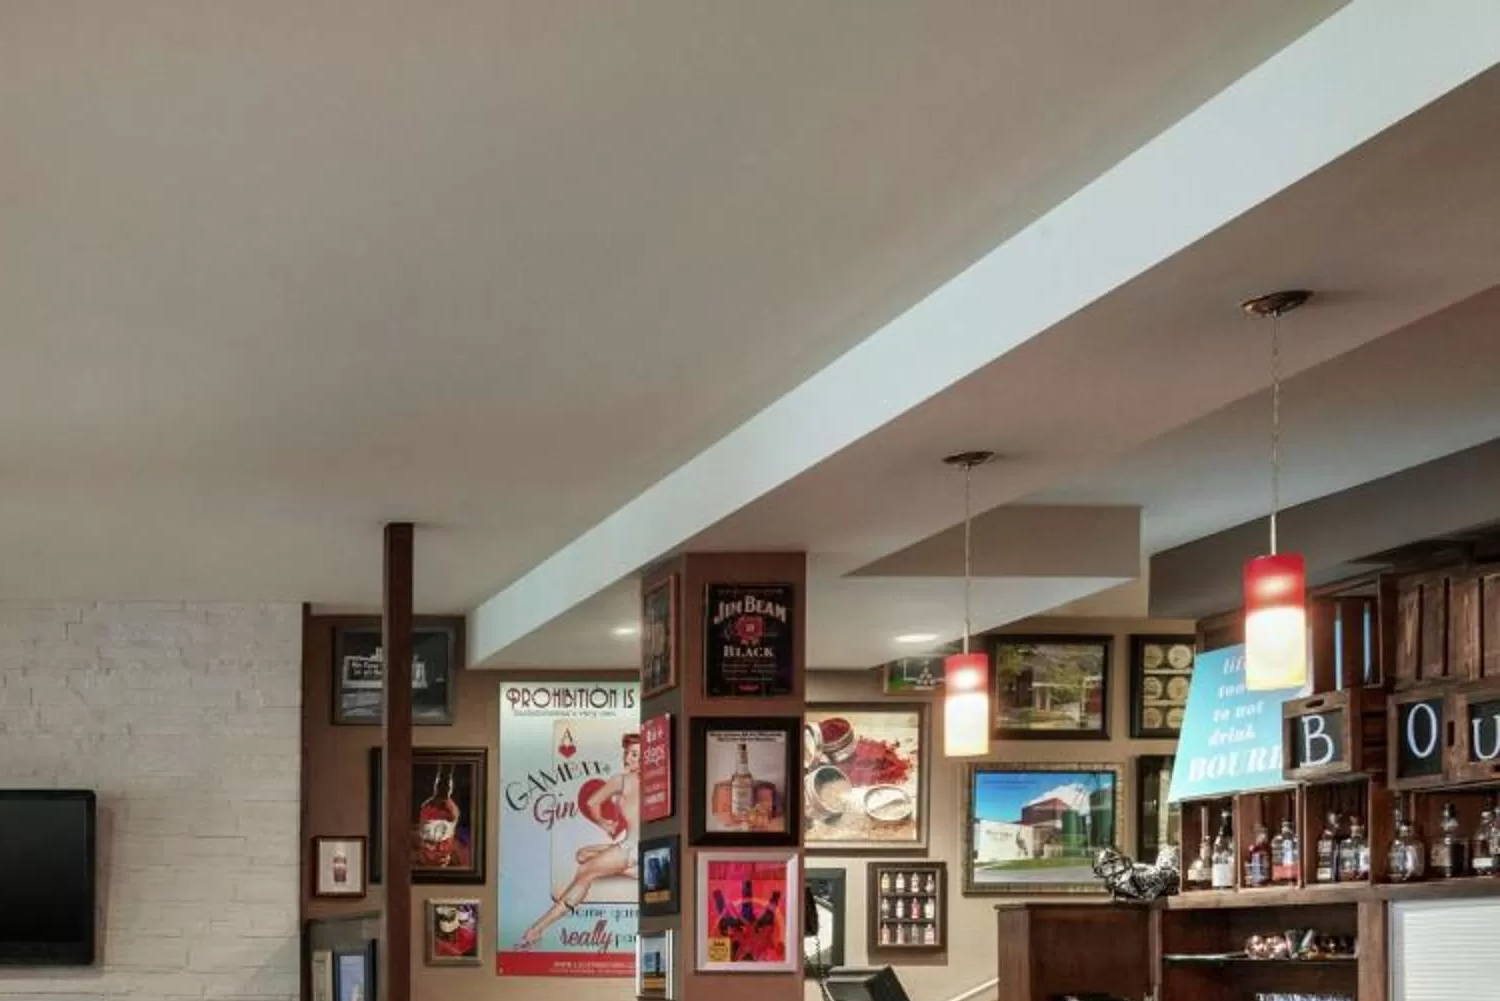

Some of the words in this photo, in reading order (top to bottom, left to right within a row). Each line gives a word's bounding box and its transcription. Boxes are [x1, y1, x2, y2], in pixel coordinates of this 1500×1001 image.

[713, 600, 743, 625] JIM
[744, 595, 787, 625] BEAM
[723, 645, 775, 657] BLACK
[506, 684, 617, 711] PROHIBITION
[623, 688, 636, 709] IS
[534, 792, 580, 831] Gin
[561, 920, 612, 955] really
